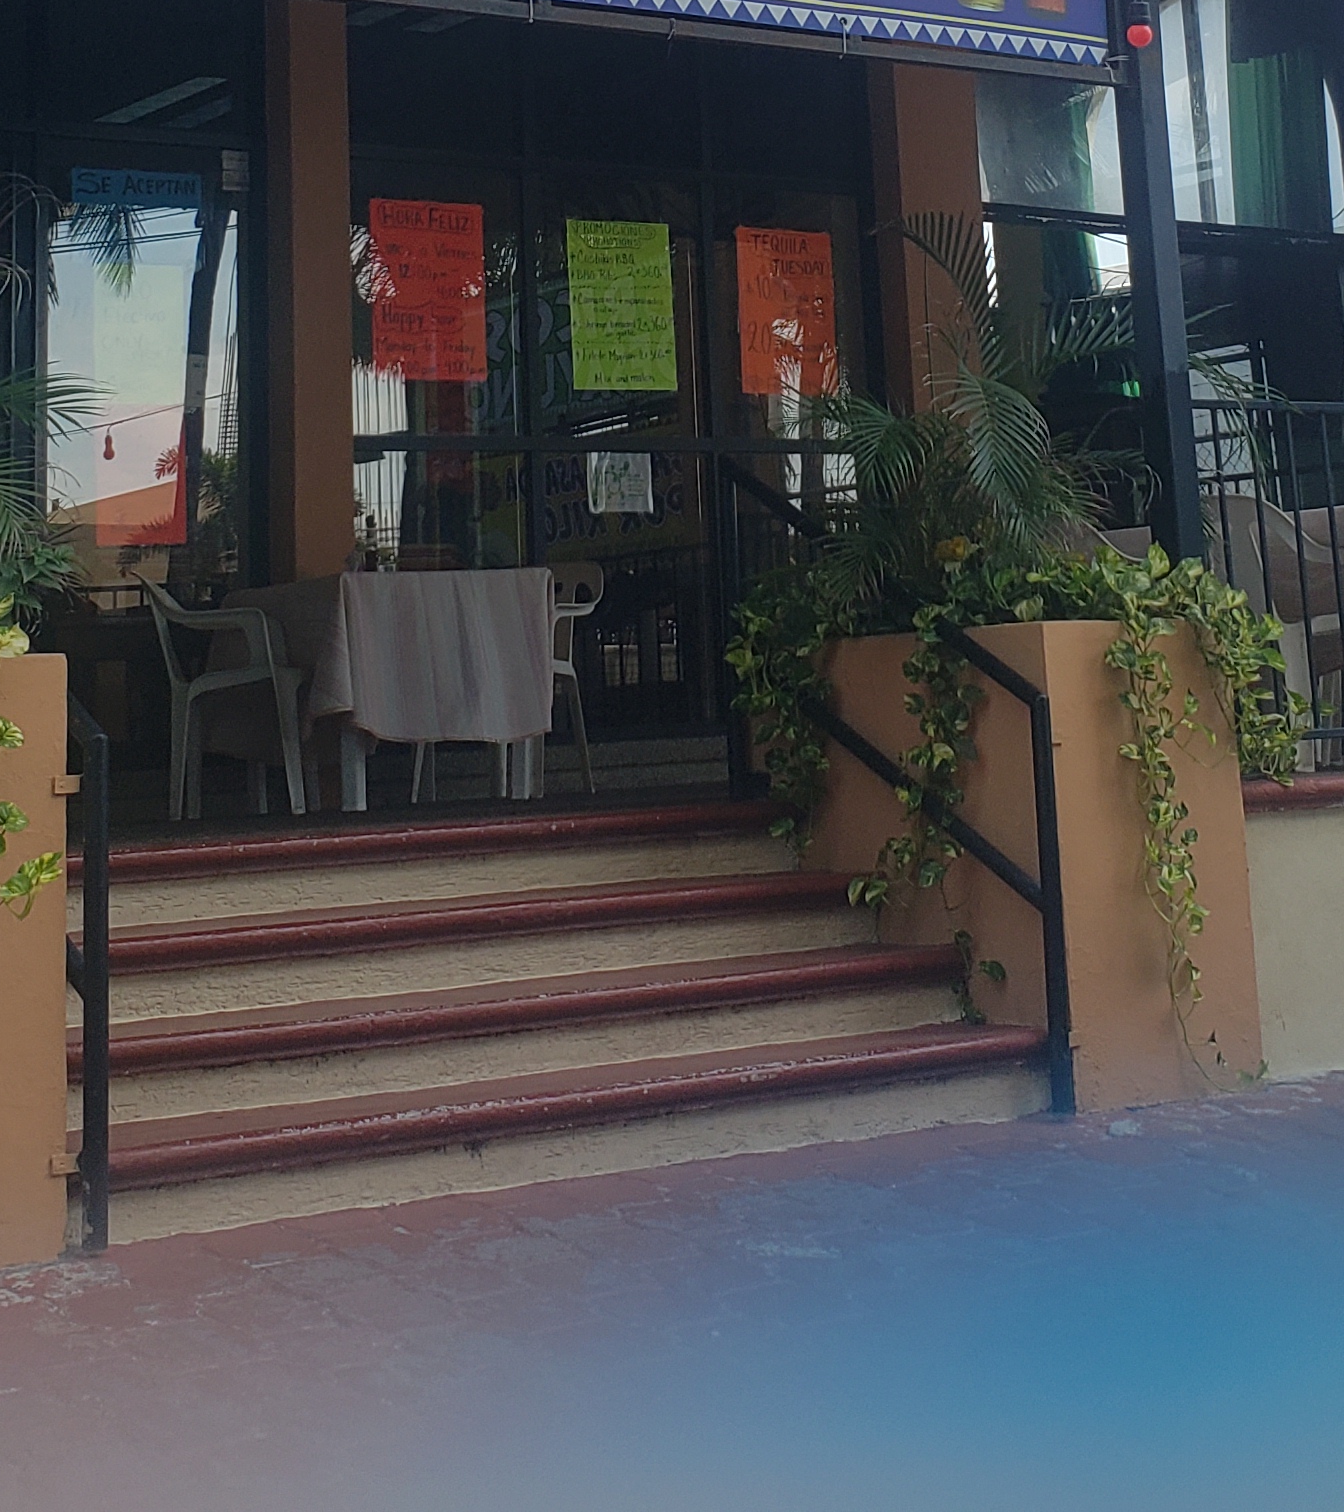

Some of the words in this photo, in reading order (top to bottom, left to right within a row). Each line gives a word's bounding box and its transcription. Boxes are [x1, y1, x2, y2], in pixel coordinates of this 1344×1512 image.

[428, 207, 470, 232] FELIZ
[749, 233, 809, 255] TEQUILA
[381, 305, 424, 333] Happy
